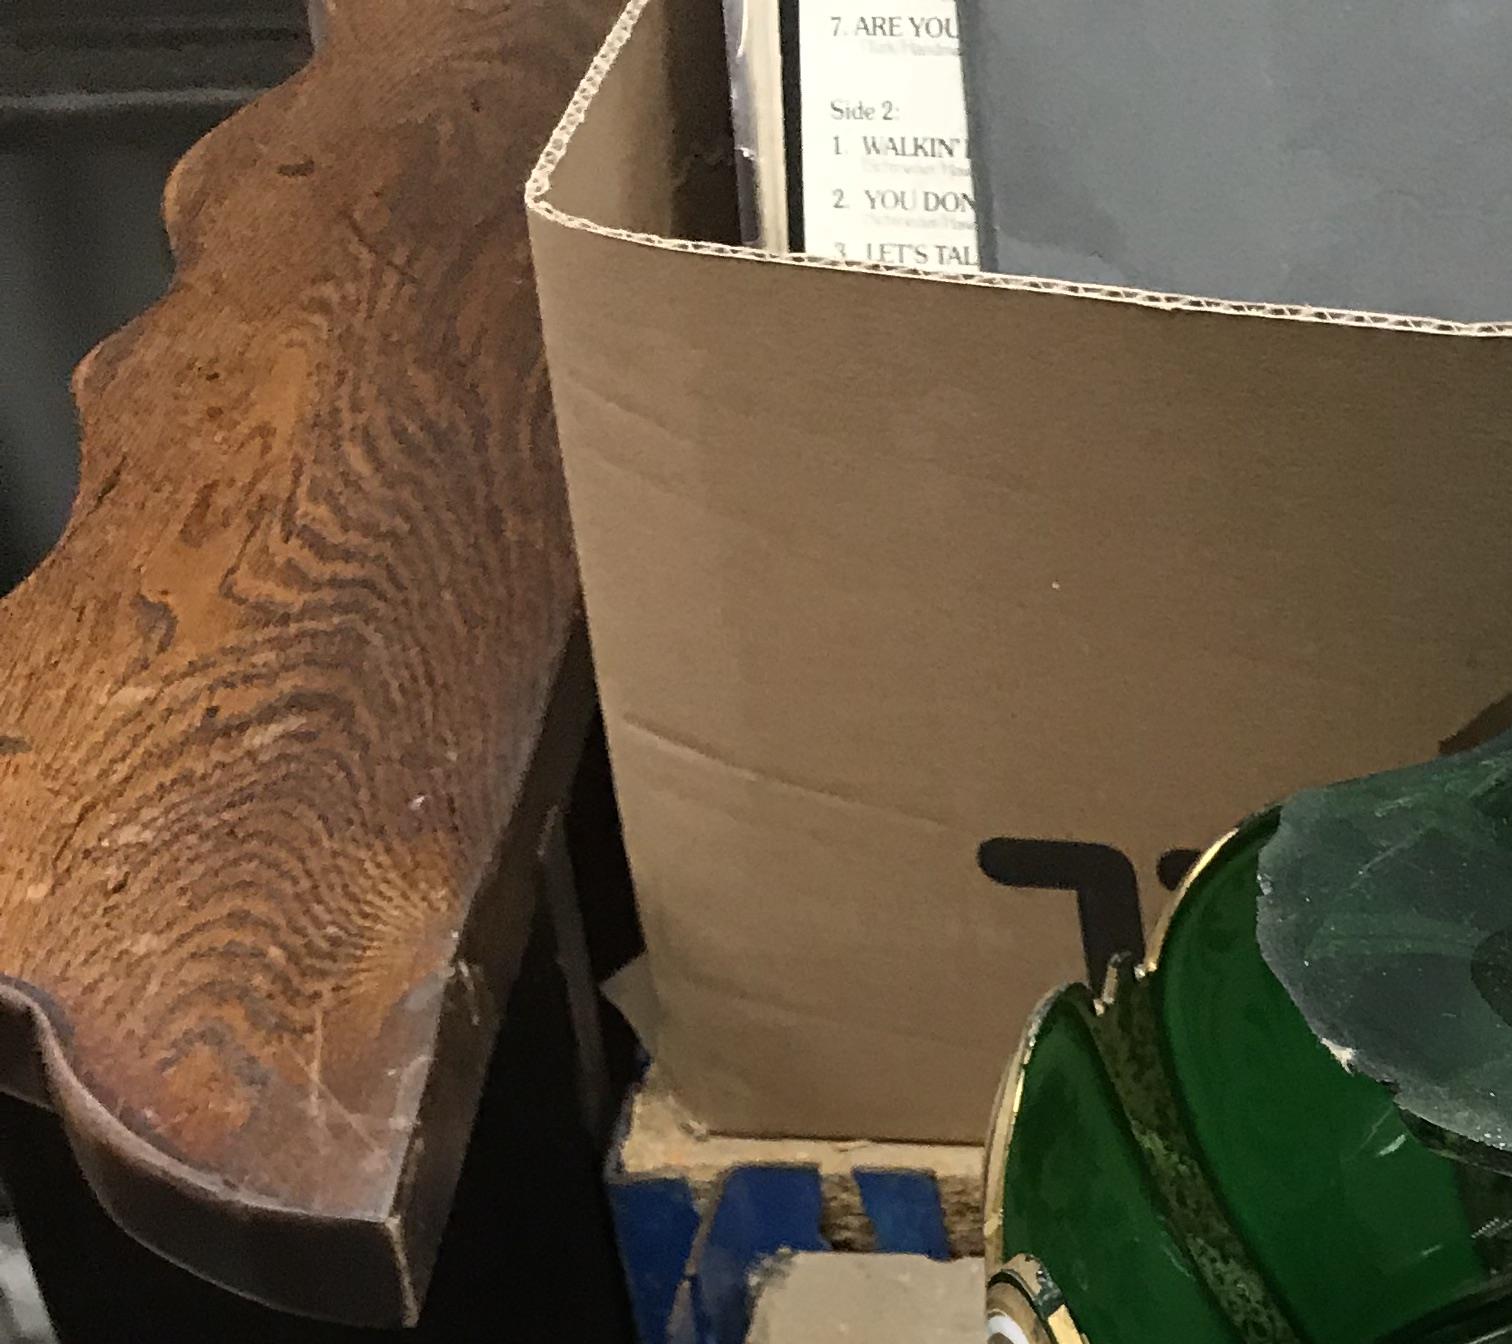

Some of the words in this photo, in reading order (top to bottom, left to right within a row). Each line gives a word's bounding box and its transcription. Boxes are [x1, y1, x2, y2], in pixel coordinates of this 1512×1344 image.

[854, 16, 903, 39] ARE
[908, 17, 960, 39] YOU
[830, 101, 876, 121] Side
[861, 136, 961, 158] WALKIN'
[864, 189, 916, 211] YOU
[866, 242, 929, 265] LET'S
